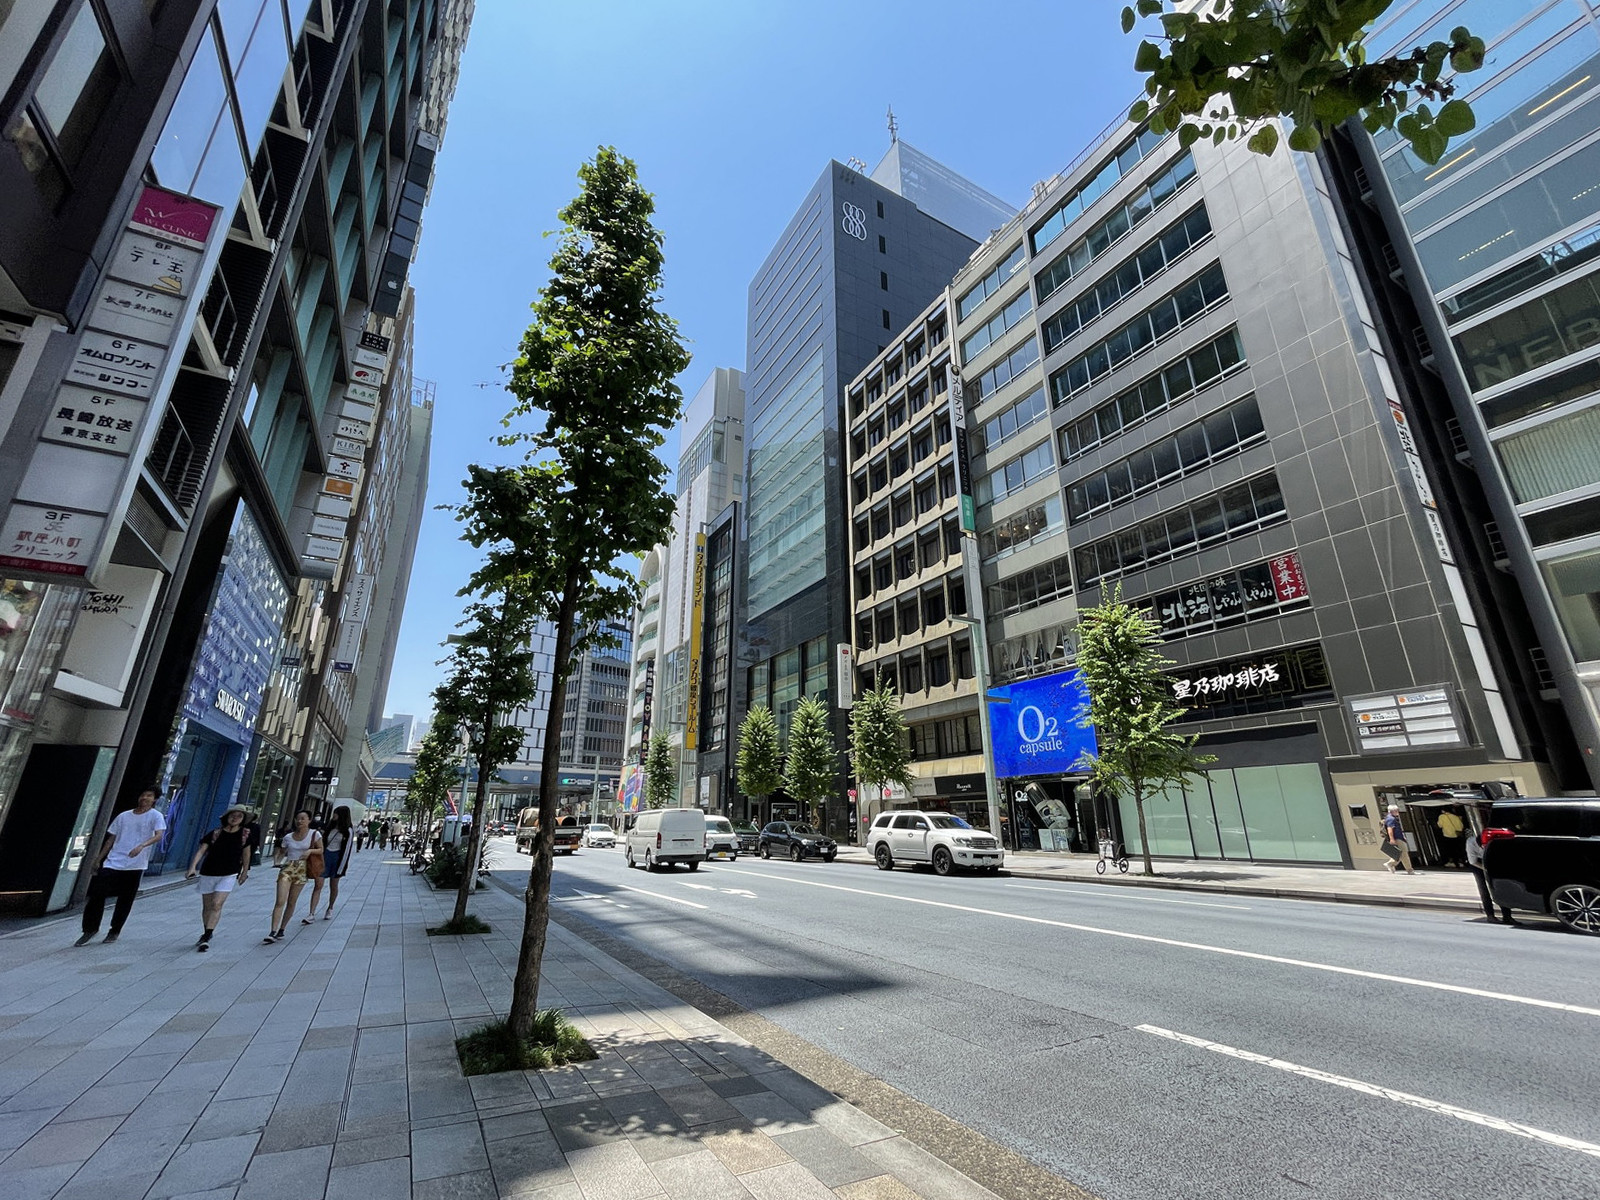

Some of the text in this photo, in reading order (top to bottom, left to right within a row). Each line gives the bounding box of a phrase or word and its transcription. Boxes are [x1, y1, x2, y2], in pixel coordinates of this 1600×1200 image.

[162, 222, 201, 238] CLINIC
[155, 241, 172, 250] 8F
[130, 250, 184, 273] テレ玉
[134, 289, 156, 299] 7F
[111, 340, 137, 351] 6F
[80, 348, 156, 370] オムロプリント
[98, 373, 148, 388] シンコー
[91, 396, 116, 406] 5F
[57, 407, 133, 433] 長崎放送
[61, 426, 118, 446] 東京支社
[337, 440, 361, 451] KIRA
[45, 511, 72, 521] 3F
[16, 531, 82, 549] 銀座小町
[11, 544, 78, 560] クリニック
[1273, 557, 1297, 599] 営業中
[86, 591, 125, 605] TOSHI
[352, 578, 366, 618] エス・サイエンス
[1172, 663, 1280, 700] 星乃珈琲店
[1017, 705, 1059, 743] O2
[641, 724, 649, 759] PARK
[1019, 736, 1063, 756] capsule
